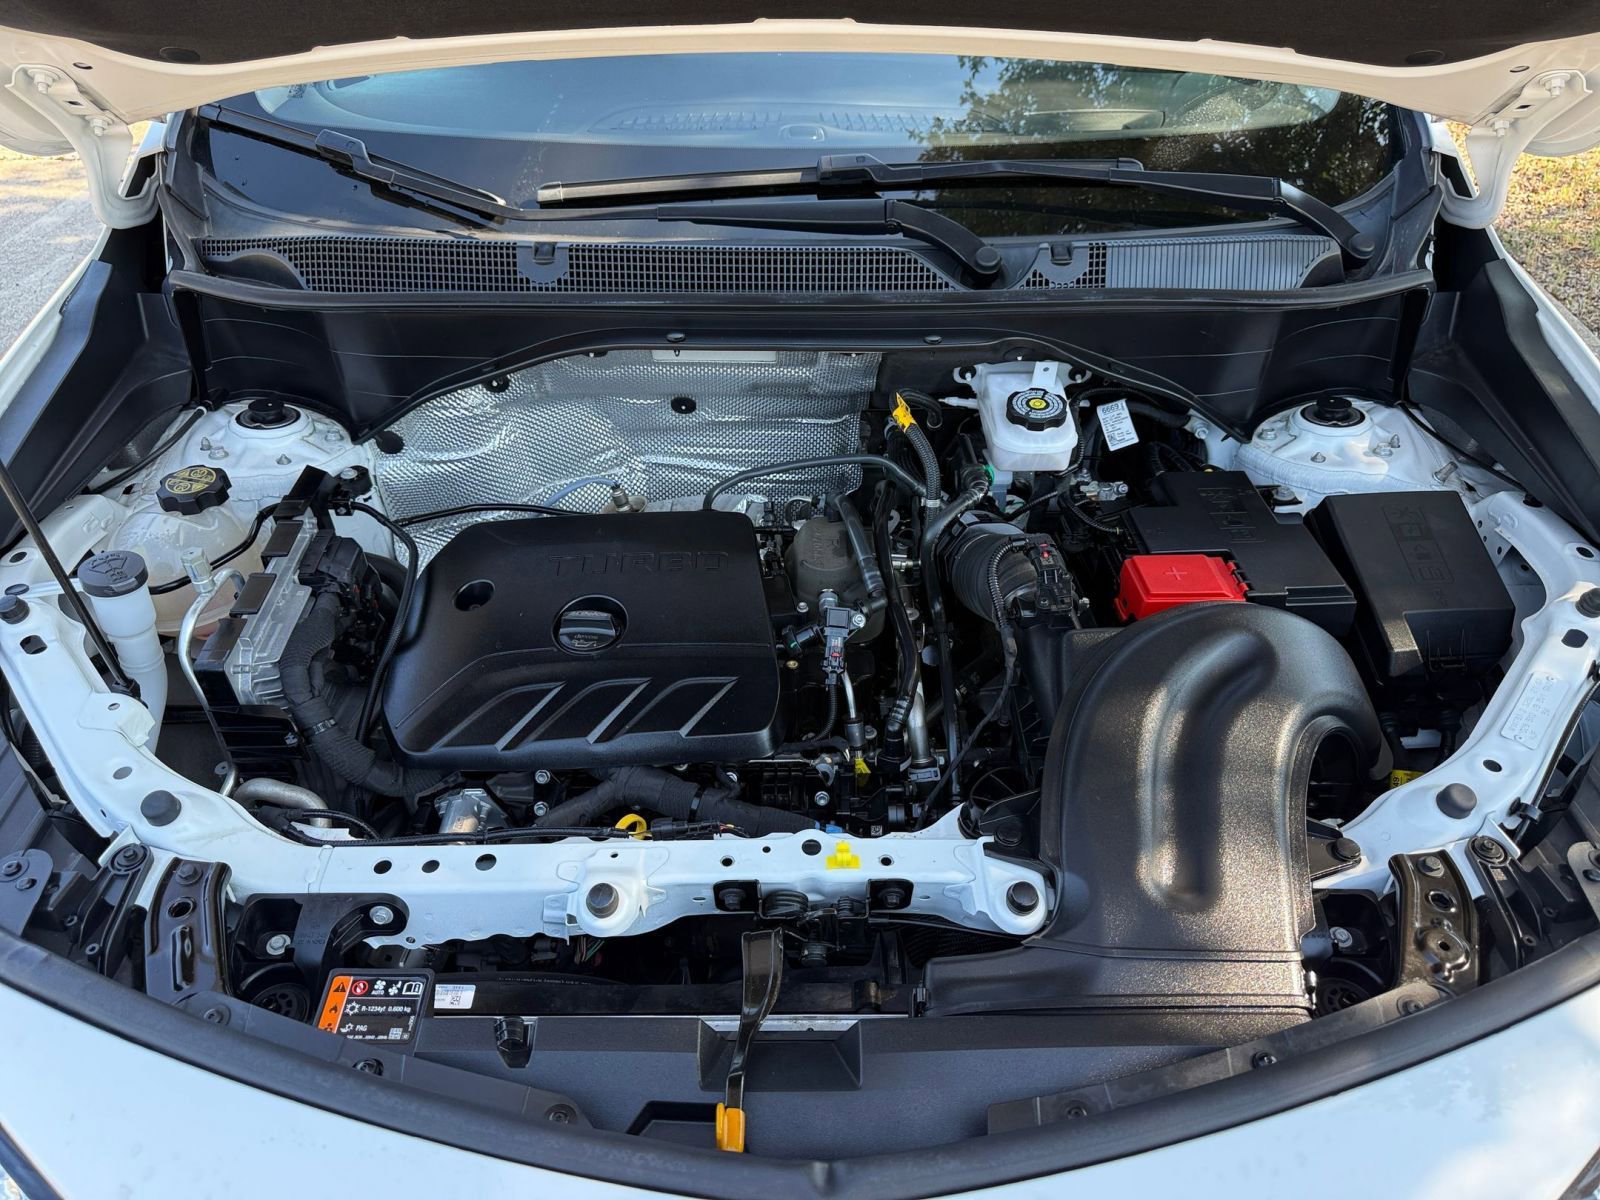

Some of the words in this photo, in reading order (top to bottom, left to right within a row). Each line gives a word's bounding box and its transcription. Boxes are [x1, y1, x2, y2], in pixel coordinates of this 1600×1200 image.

[1102, 403, 1119, 413] 6669
[549, 551, 729, 576] TURBO
[361, 1006, 387, 1014] R-1234yf
